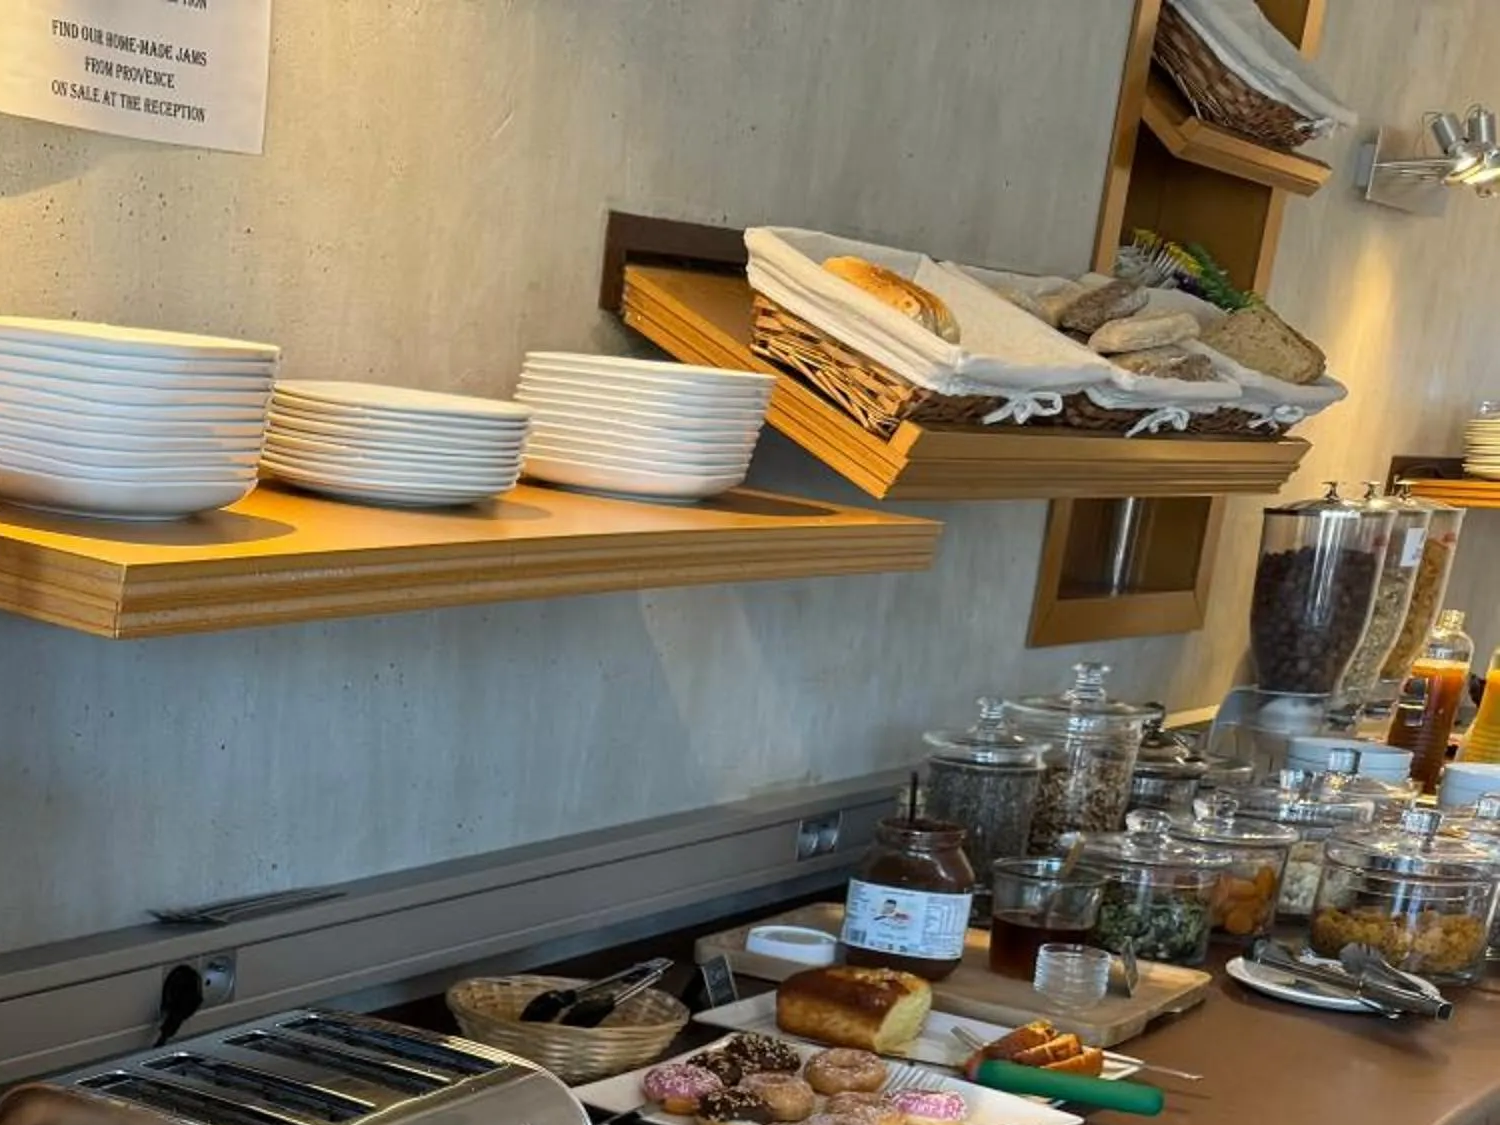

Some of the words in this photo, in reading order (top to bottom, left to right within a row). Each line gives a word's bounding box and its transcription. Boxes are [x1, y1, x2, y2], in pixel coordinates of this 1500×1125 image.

[52, 19, 79, 39] FIND
[81, 26, 103, 45] OUR
[105, 32, 173, 60] HOME-MADE
[175, 47, 207, 67] JAMS
[84, 56, 114, 77] FROM
[115, 63, 175, 89] PROVENCE
[51, 80, 67, 96] ON
[70, 83, 100, 103] SALE
[102, 90, 118, 107] AT
[120, 93, 141, 111] THE
[143, 98, 207, 122] RECEPTION
